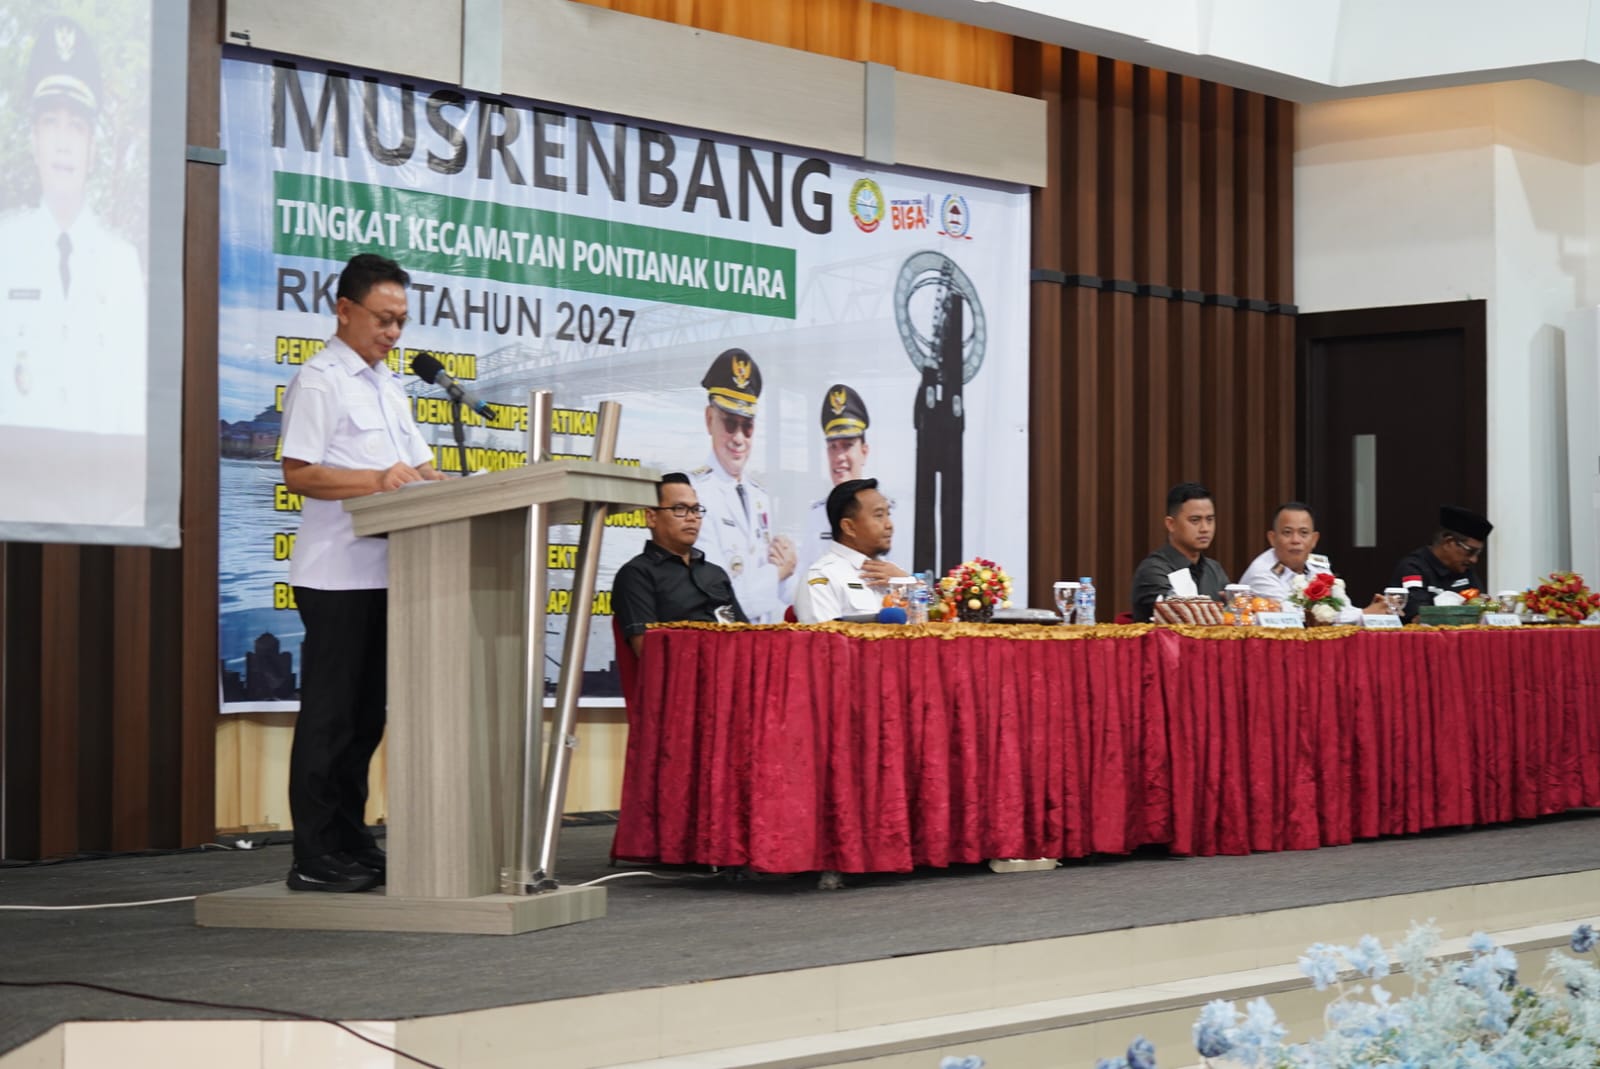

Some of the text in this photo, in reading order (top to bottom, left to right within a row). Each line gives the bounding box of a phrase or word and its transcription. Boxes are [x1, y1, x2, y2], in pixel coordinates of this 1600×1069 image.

[271, 59, 833, 236] MUSRENBANG
[276, 198, 787, 301] TINGKAT KECAMATAN PONTIANAK UTARA
[411, 283, 543, 339] TAHUN
[556, 302, 636, 348] 2027
[403, 348, 477, 380] ENOMI
